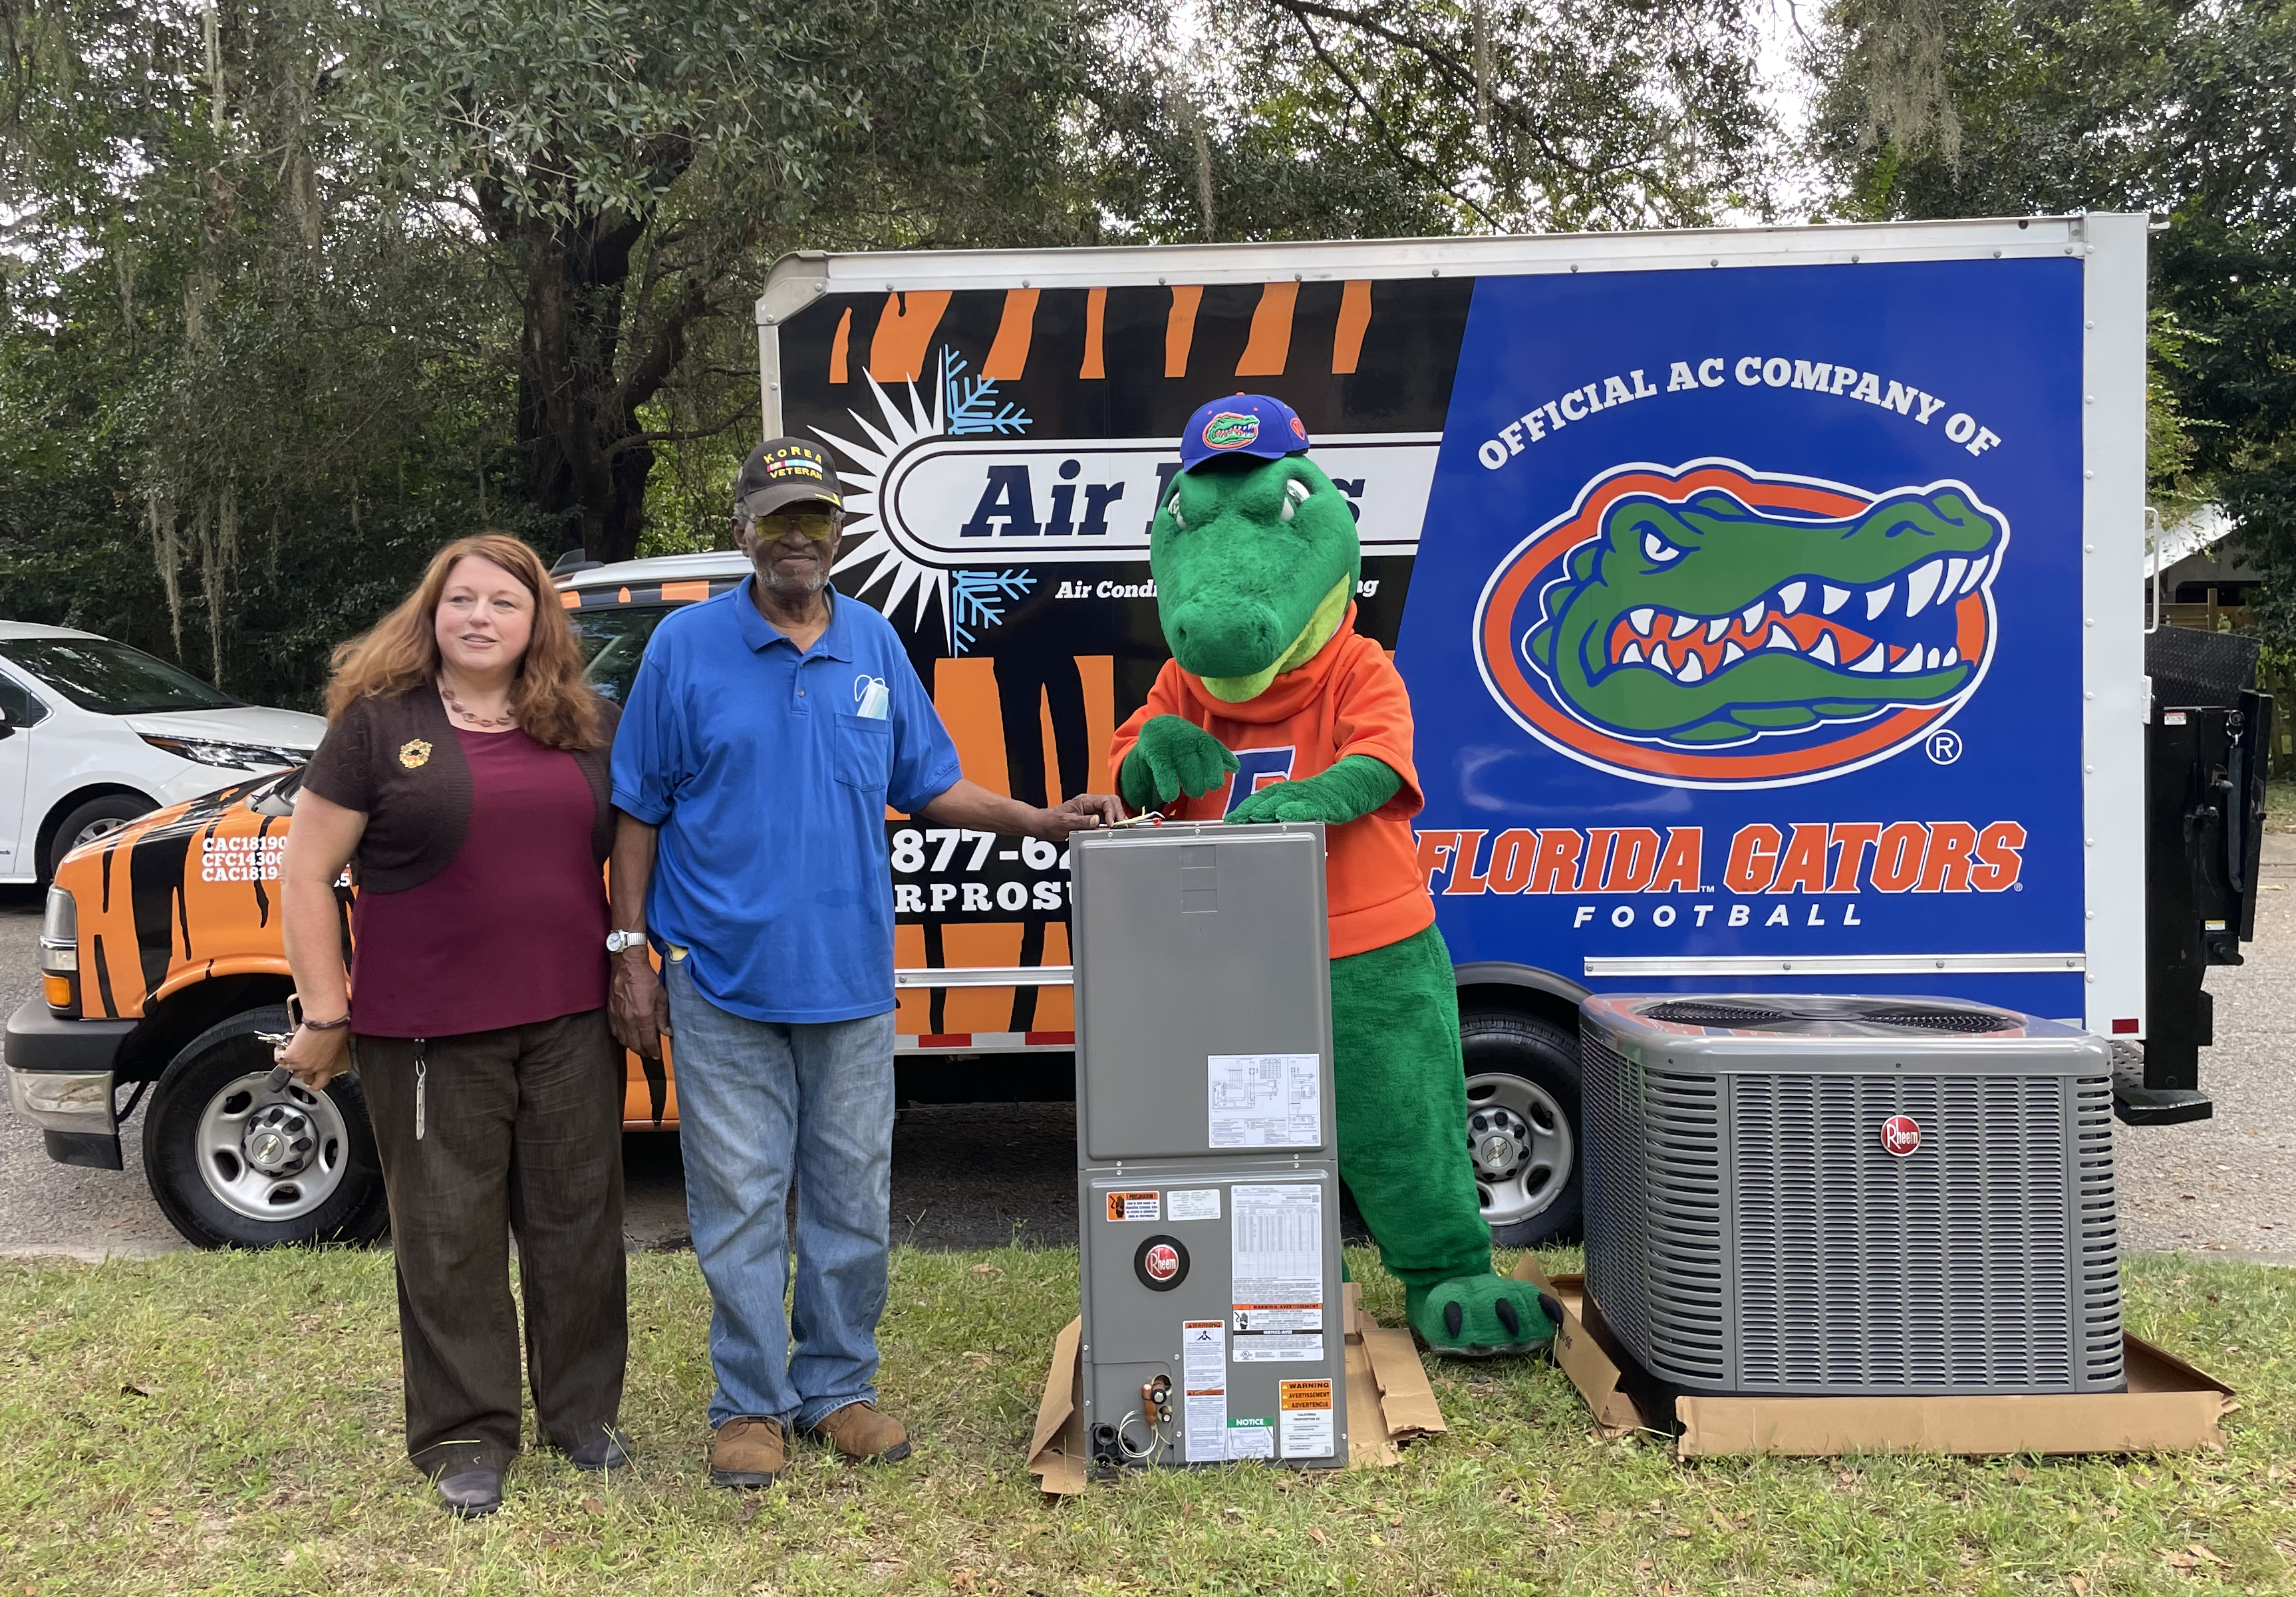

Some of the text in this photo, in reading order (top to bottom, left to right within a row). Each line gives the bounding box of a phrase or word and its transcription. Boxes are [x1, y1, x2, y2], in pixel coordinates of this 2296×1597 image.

[1478, 356, 2002, 470] OFFICIAL AC COMPANY OF
[763, 446, 822, 464] KOREA
[770, 466, 823, 480] VETERAN
[960, 459, 1125, 537] Air
[1054, 580, 1092, 599] Air
[1414, 826, 1703, 895] FLORIDA
[1723, 821, 2027, 895] GATORS
[1573, 903, 1862, 929] FOOTBALL
[1886, 1117, 1918, 1149] Rheem
[1149, 1249, 1177, 1274] Rheem
